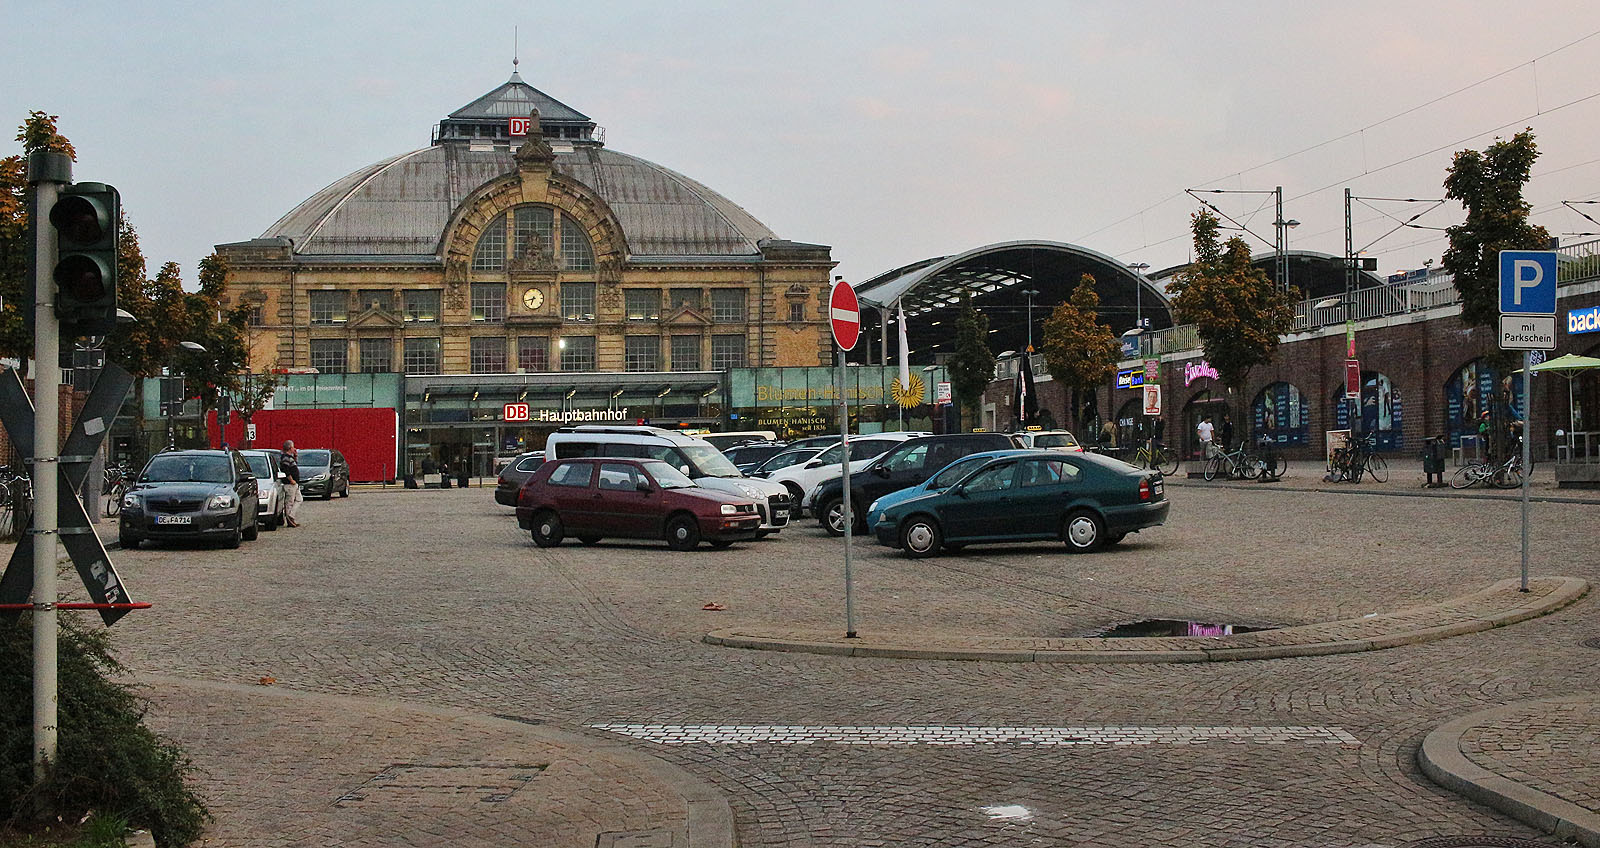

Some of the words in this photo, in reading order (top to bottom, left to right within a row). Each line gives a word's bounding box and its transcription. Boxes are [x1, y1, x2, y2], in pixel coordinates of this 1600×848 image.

[1513, 259, 1544, 305] P
[1521, 322, 1535, 332] mit
[1504, 333, 1552, 343] Parkschein
[505, 405, 527, 419] DB
[540, 407, 628, 424] Hauptbahnhof
[791, 417, 826, 425] HANISCH
